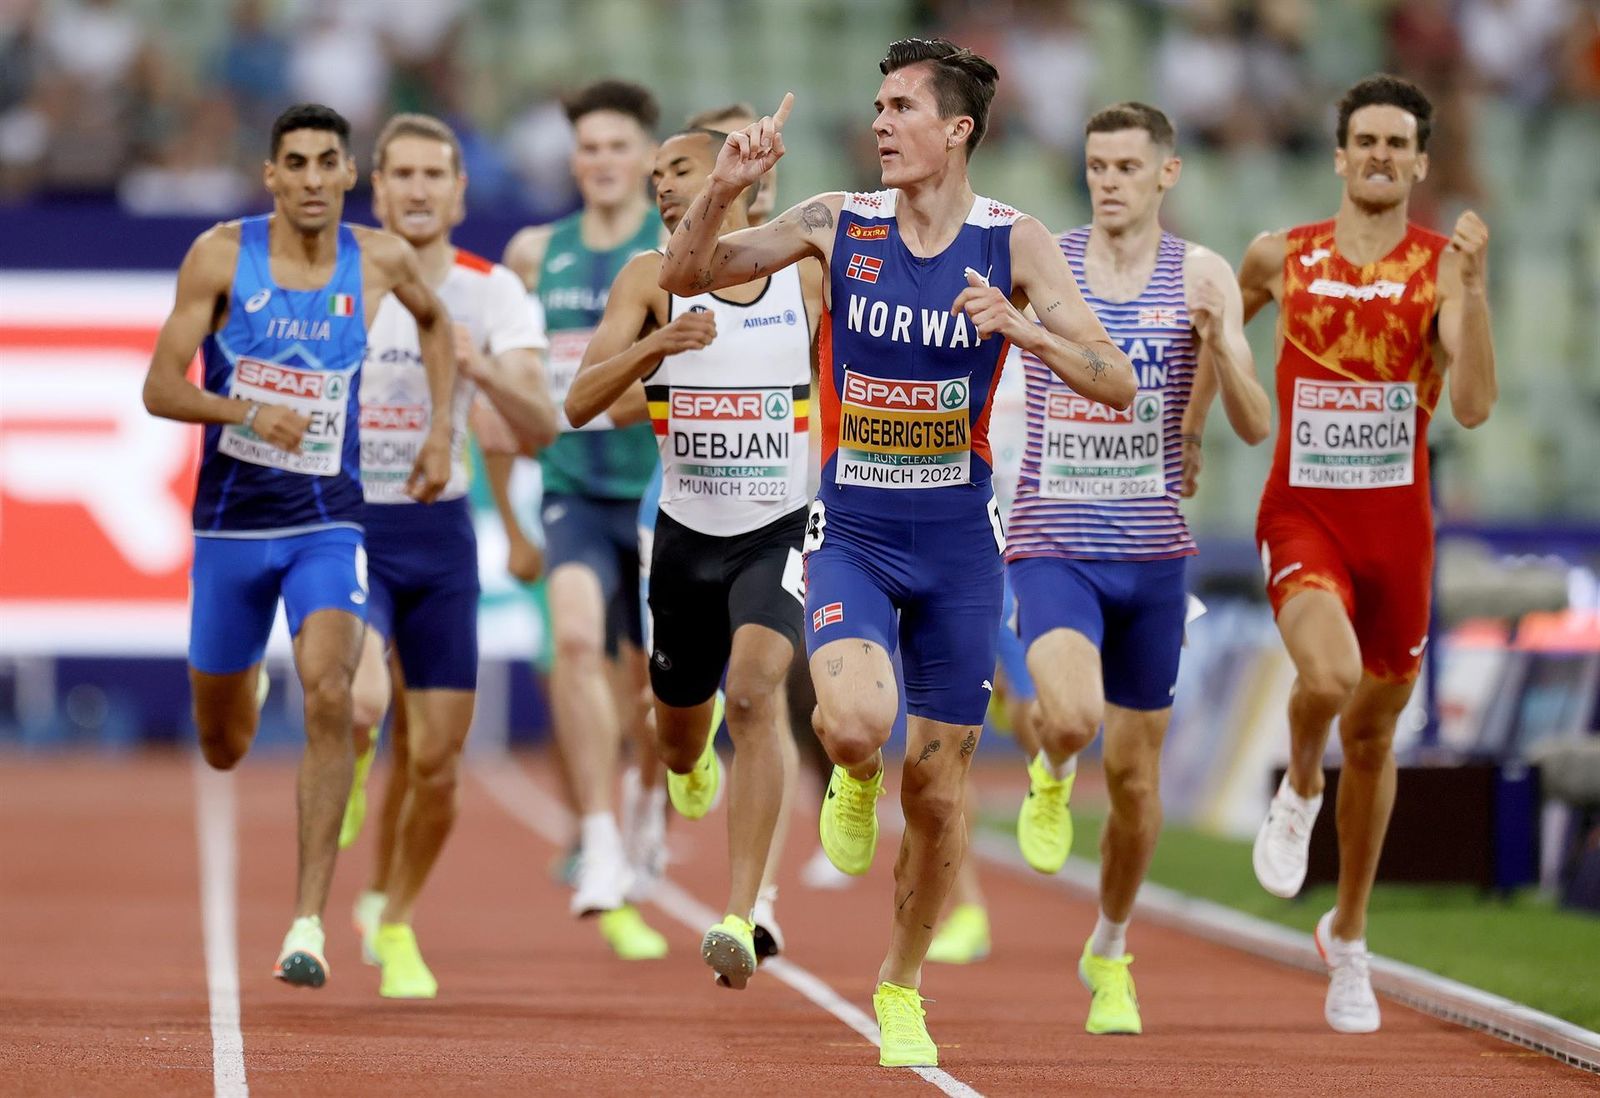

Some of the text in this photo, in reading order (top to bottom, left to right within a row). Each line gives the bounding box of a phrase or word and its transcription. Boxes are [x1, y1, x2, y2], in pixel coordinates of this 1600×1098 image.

[862, 228, 887, 237] EXTRA
[266, 318, 331, 341] ITALIA
[743, 314, 782, 328] Allianz
[238, 362, 322, 397] SPAR
[848, 378, 935, 407] SPAR
[1298, 388, 1382, 408] SPAR
[673, 395, 761, 418] SPAR
[842, 413, 967, 448] INGEBRIGTSEN
[1297, 416, 1410, 449] G. GARCÍA
[674, 431, 789, 459] DEBJANI
[1048, 432, 1159, 460] HEYWARD
[874, 453, 897, 464] RUN
[844, 464, 962, 483] MUNICH 2022
[1299, 467, 1405, 483] MUNICH 2022
[679, 479, 786, 496] MUNICH 2022
[1047, 479, 1157, 496] MUNICH 2022
